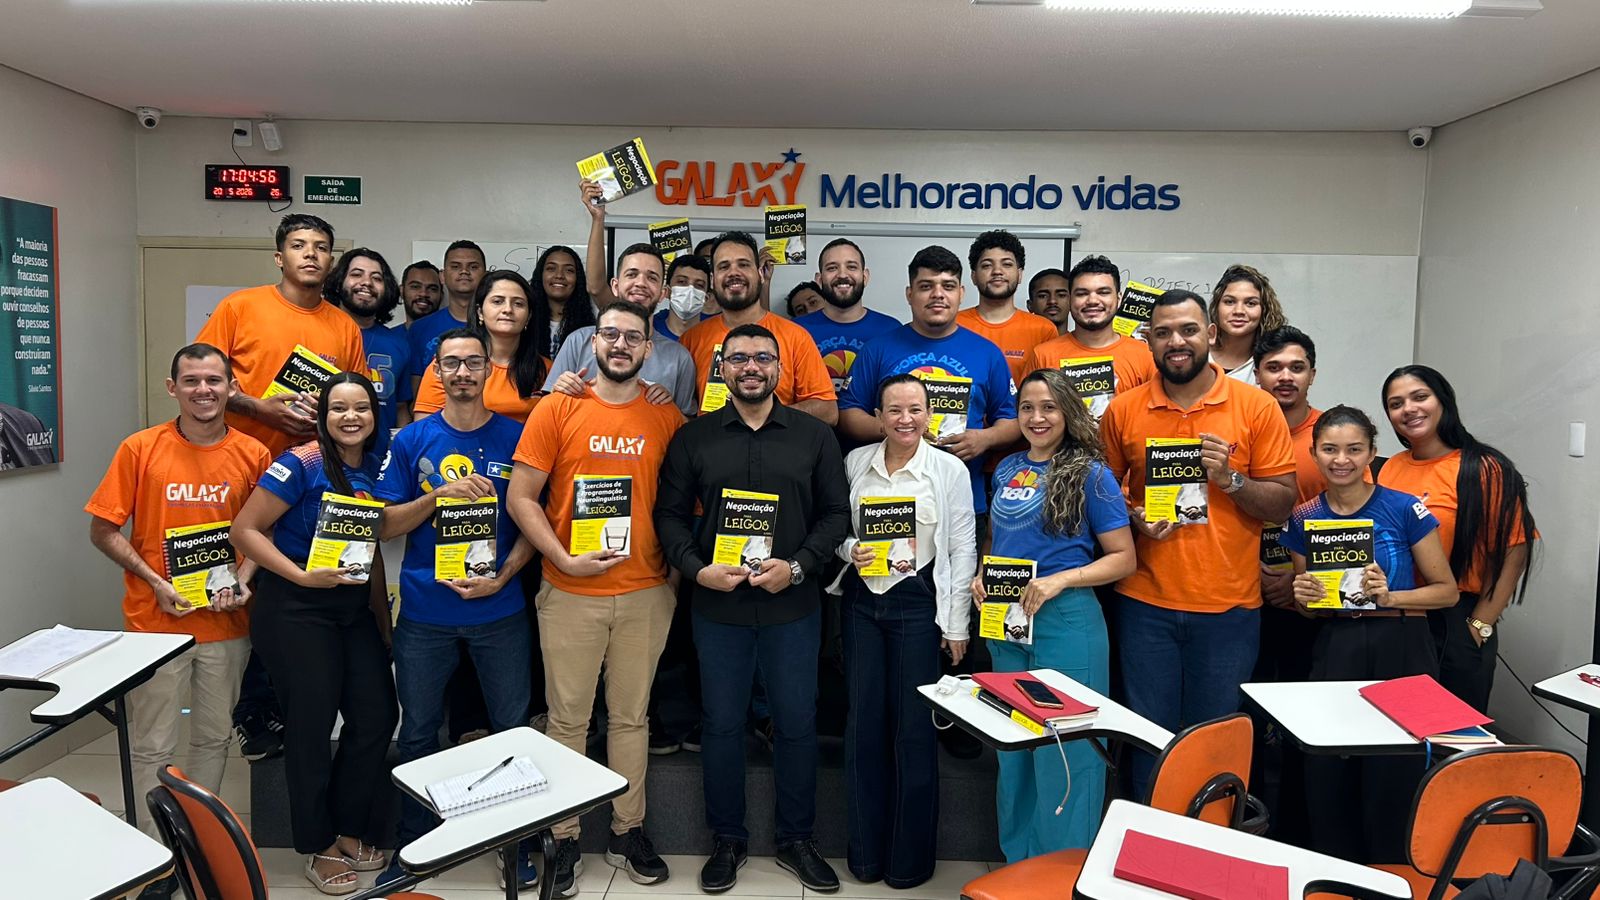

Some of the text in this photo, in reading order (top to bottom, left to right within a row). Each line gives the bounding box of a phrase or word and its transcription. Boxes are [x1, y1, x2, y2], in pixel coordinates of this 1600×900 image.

[611, 151, 635, 190] LEIGOS
[625, 145, 649, 186] Negociação
[222, 169, 277, 184] 17:04:56
[320, 178, 345, 186] SAÍDA
[213, 187, 224, 196] 20
[236, 187, 254, 196] 2026
[655, 160, 1182, 212] GALAXY Melhorando vidas
[307, 194, 359, 202] EMERGÊNCIA
[767, 212, 805, 221] Negociação
[652, 225, 689, 239] Negociação
[769, 223, 804, 235] LEIGOS
[25, 240, 48, 252] maioria
[12, 252, 48, 267] das pessoas
[17, 269, 49, 283] fracassam
[0, 285, 49, 298] porque decidem
[2, 300, 50, 313] ouvir conselhos
[16, 316, 50, 330] de pessoas
[20, 335, 50, 346] que nunca
[291, 356, 331, 382] Negociaçã
[892, 352, 937, 375] FORÇA
[1065, 364, 1113, 378] Negociação
[1075, 379, 1110, 393] EIGOS
[928, 397, 965, 410] EIGOS
[26, 430, 54, 446] GALAXY
[589, 435, 646, 456] GALAXY
[1152, 466, 1203, 479] LEIGOS
[165, 483, 231, 504] GALAXY
[325, 504, 379, 520] Negociação
[441, 506, 494, 520] Negociação
[585, 505, 618, 515] LEIGOS
[726, 501, 775, 514] Negociação
[865, 505, 914, 518] Negociação
[322, 520, 373, 537] LEIGOS
[442, 523, 492, 537] LEIGOS
[724, 517, 770, 531] LEIGOS
[866, 521, 912, 535] LEIGOS
[173, 531, 230, 550] Negociação
[1310, 531, 1371, 545] Negociação
[176, 548, 230, 568] LEIGOS
[1312, 549, 1369, 564] LEIGOS
[986, 568, 1031, 580] Negociação
